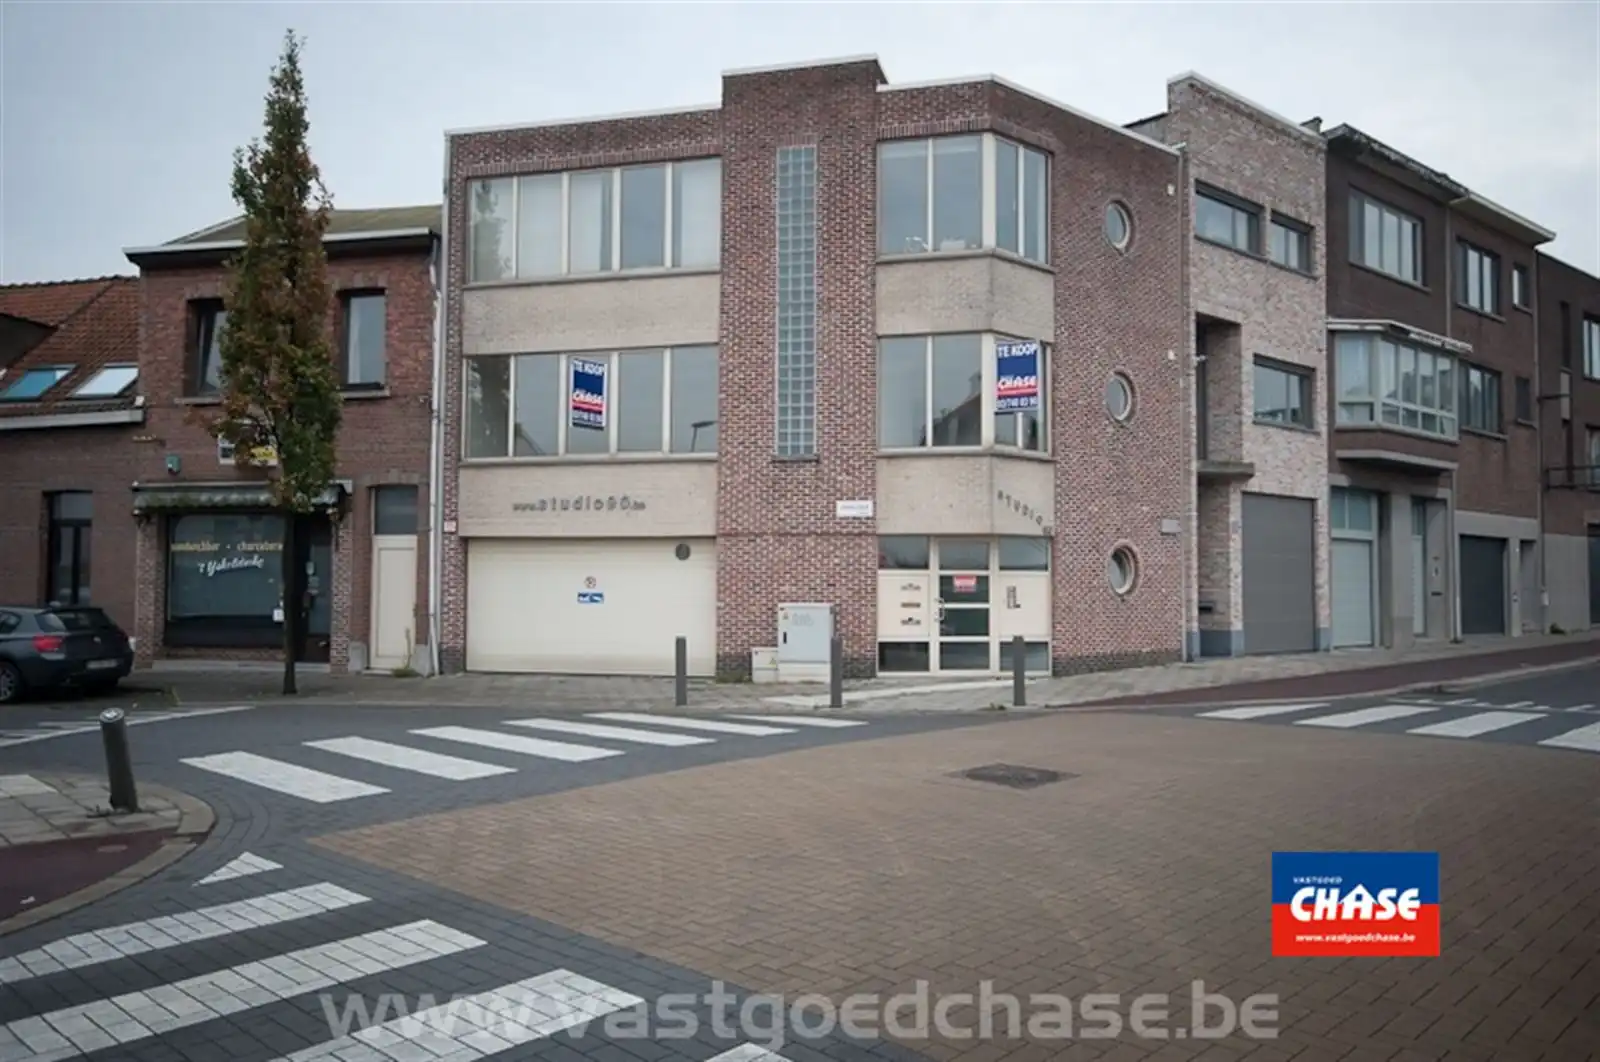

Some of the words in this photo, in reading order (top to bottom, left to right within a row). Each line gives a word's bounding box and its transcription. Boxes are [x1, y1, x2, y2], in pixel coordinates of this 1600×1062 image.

[998, 344, 1010, 358] TE
[1011, 342, 1037, 356] KOOP
[573, 359, 583, 372] TE
[584, 362, 604, 376] KOOP
